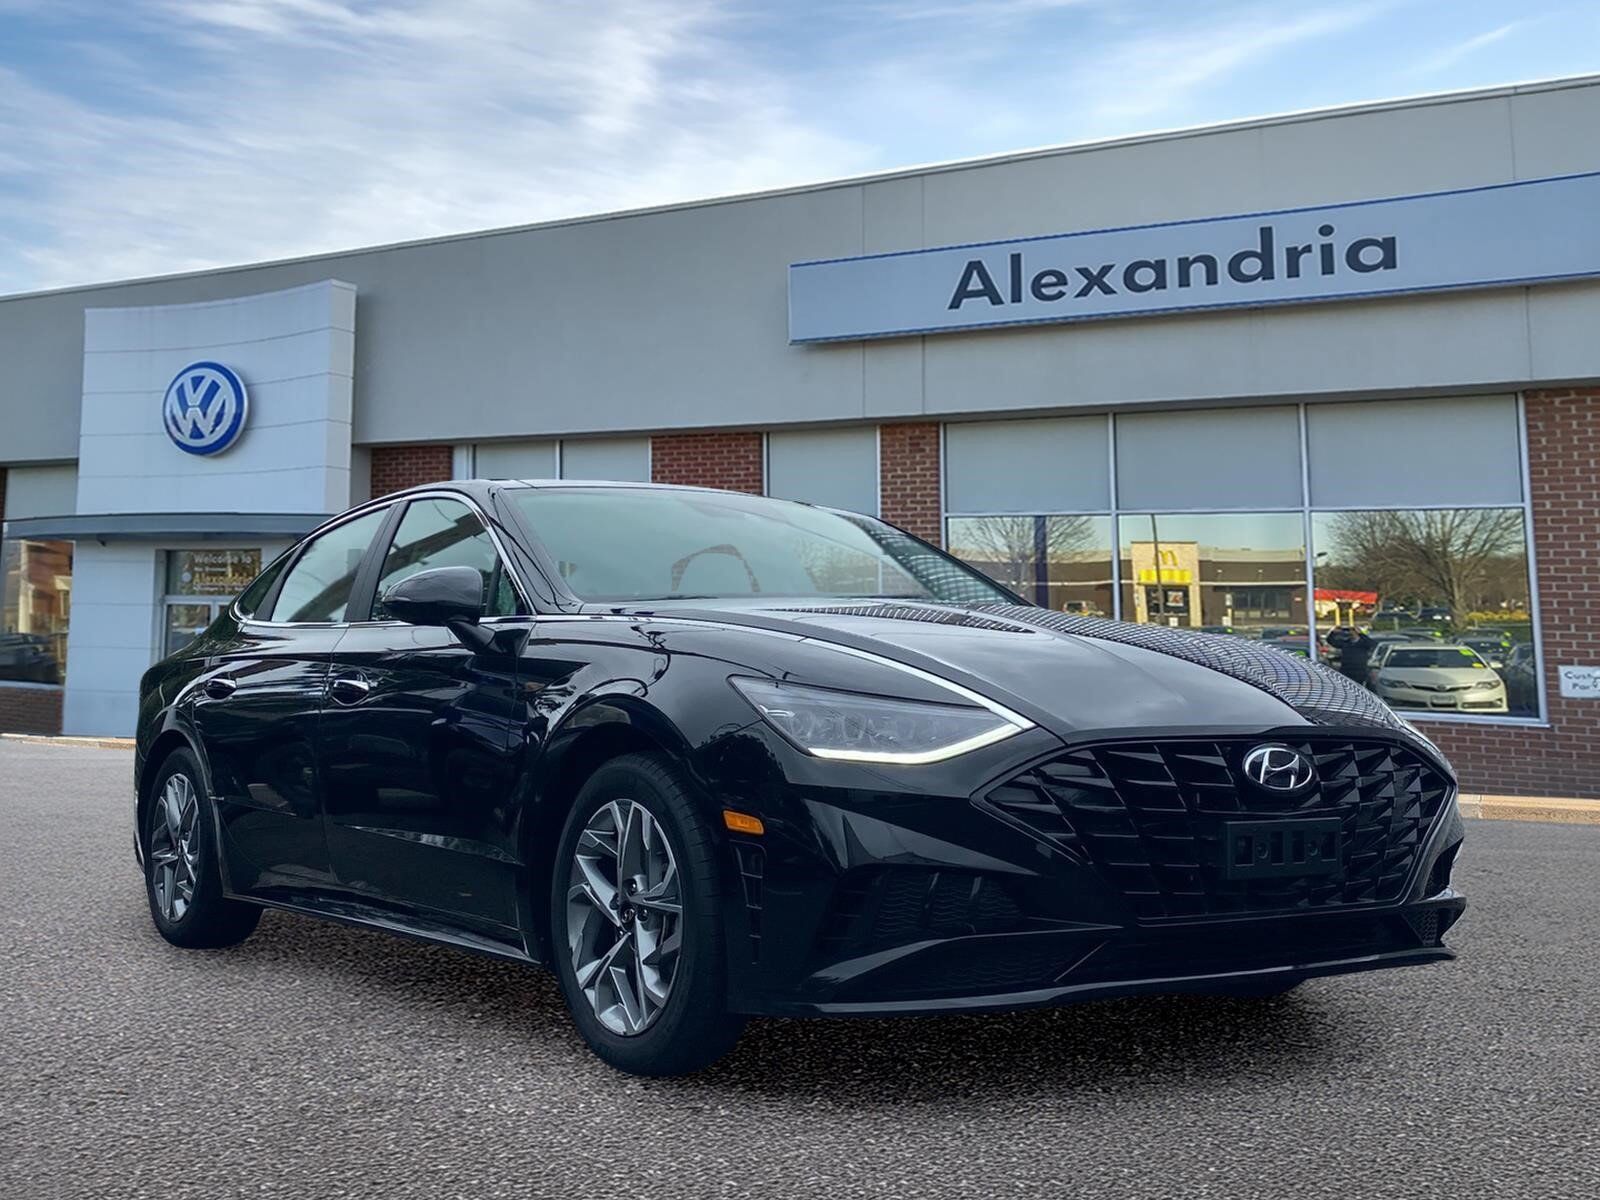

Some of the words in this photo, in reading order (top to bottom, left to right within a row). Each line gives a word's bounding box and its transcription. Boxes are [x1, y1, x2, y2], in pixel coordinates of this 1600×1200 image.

[948, 224, 1398, 310] Alexandria
[165, 365, 241, 450] VW
[193, 554, 239, 564] Welcome
